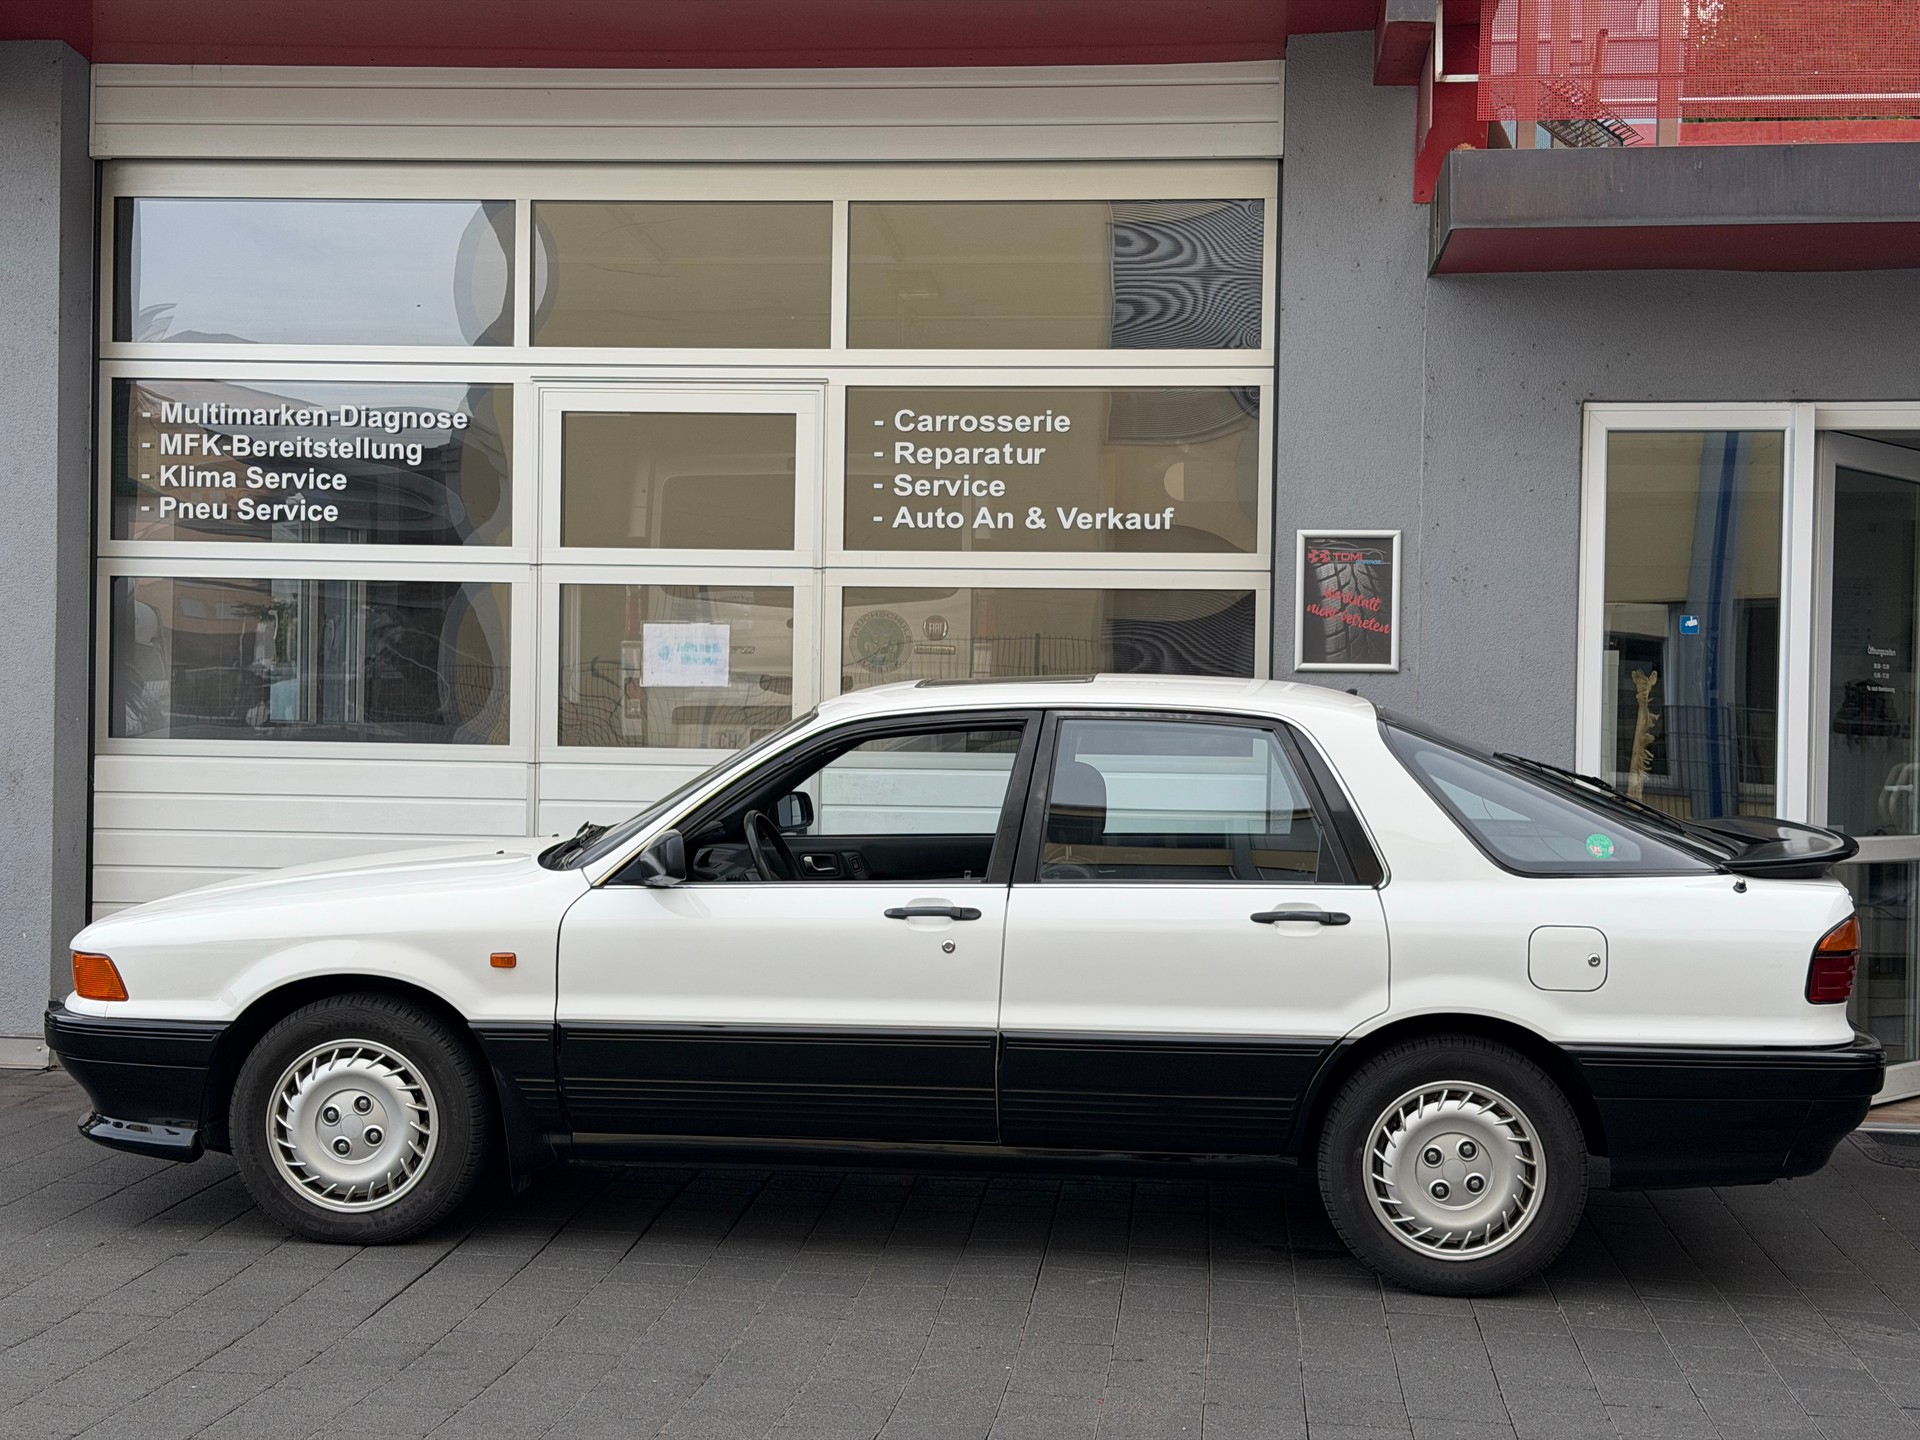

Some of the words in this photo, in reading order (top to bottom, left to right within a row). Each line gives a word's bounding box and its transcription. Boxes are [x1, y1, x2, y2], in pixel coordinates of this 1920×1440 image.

[160, 401, 468, 433] Multimarken-Diagnose
[894, 409, 1071, 433] Carrosserie
[160, 433, 422, 466] MFK-Bereitstellung
[894, 441, 1047, 470] Reparatur
[160, 464, 237, 488] Klima
[245, 466, 347, 490] Service
[893, 473, 1006, 497] Service
[159, 496, 228, 520] Pneu
[237, 497, 339, 522] Service
[892, 506, 965, 529] Auto
[972, 506, 1014, 529] An
[1025, 506, 1047, 530] &
[1056, 507, 1175, 530] Verkauf
[1332, 552, 1363, 562] TOMI
[928, 623, 943, 635] FIAT
[1306, 603, 1339, 619] nicht
[1341, 610, 1390, 634] betreten
